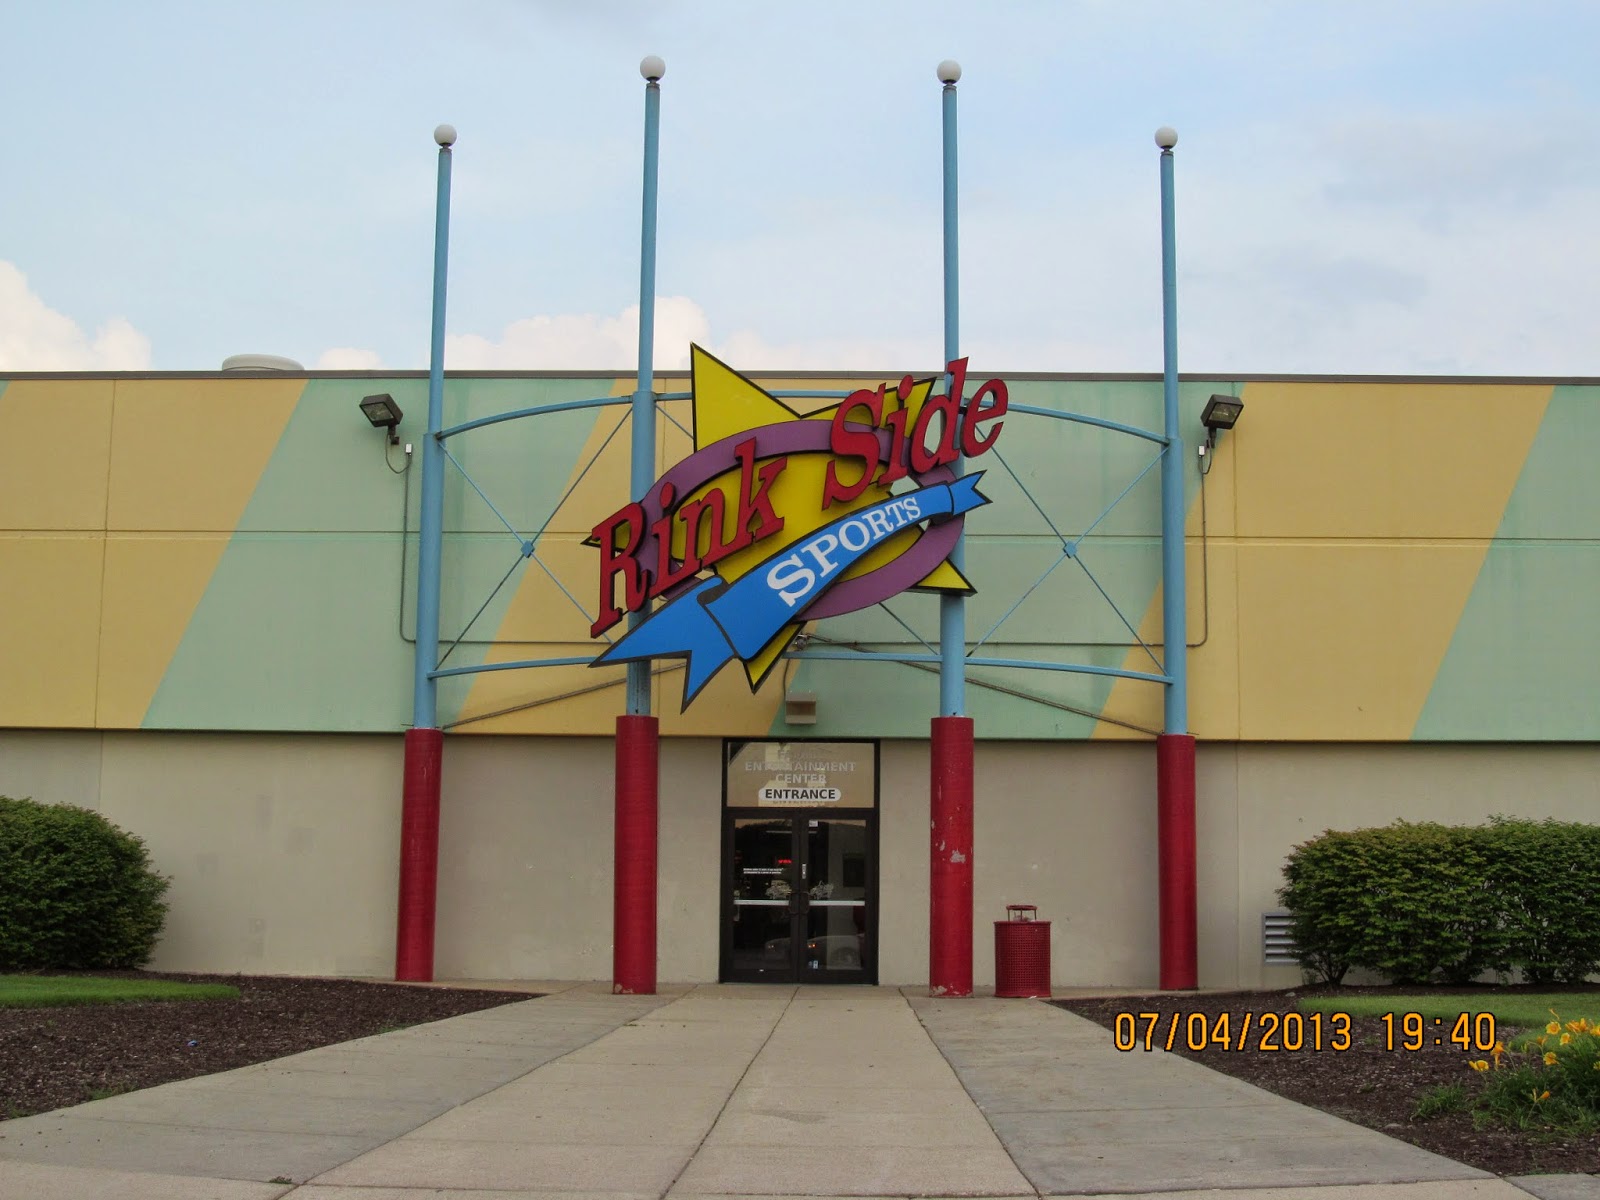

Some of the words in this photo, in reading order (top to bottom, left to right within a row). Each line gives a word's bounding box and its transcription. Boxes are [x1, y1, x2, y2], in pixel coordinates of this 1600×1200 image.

[590, 436, 788, 639] Rink
[821, 356, 1009, 510] Side
[766, 496, 922, 608] SPORTS
[744, 761, 858, 773] ENTTAINMENT
[775, 773, 827, 784] CENTER
[765, 788, 836, 799] ENTRANCE
